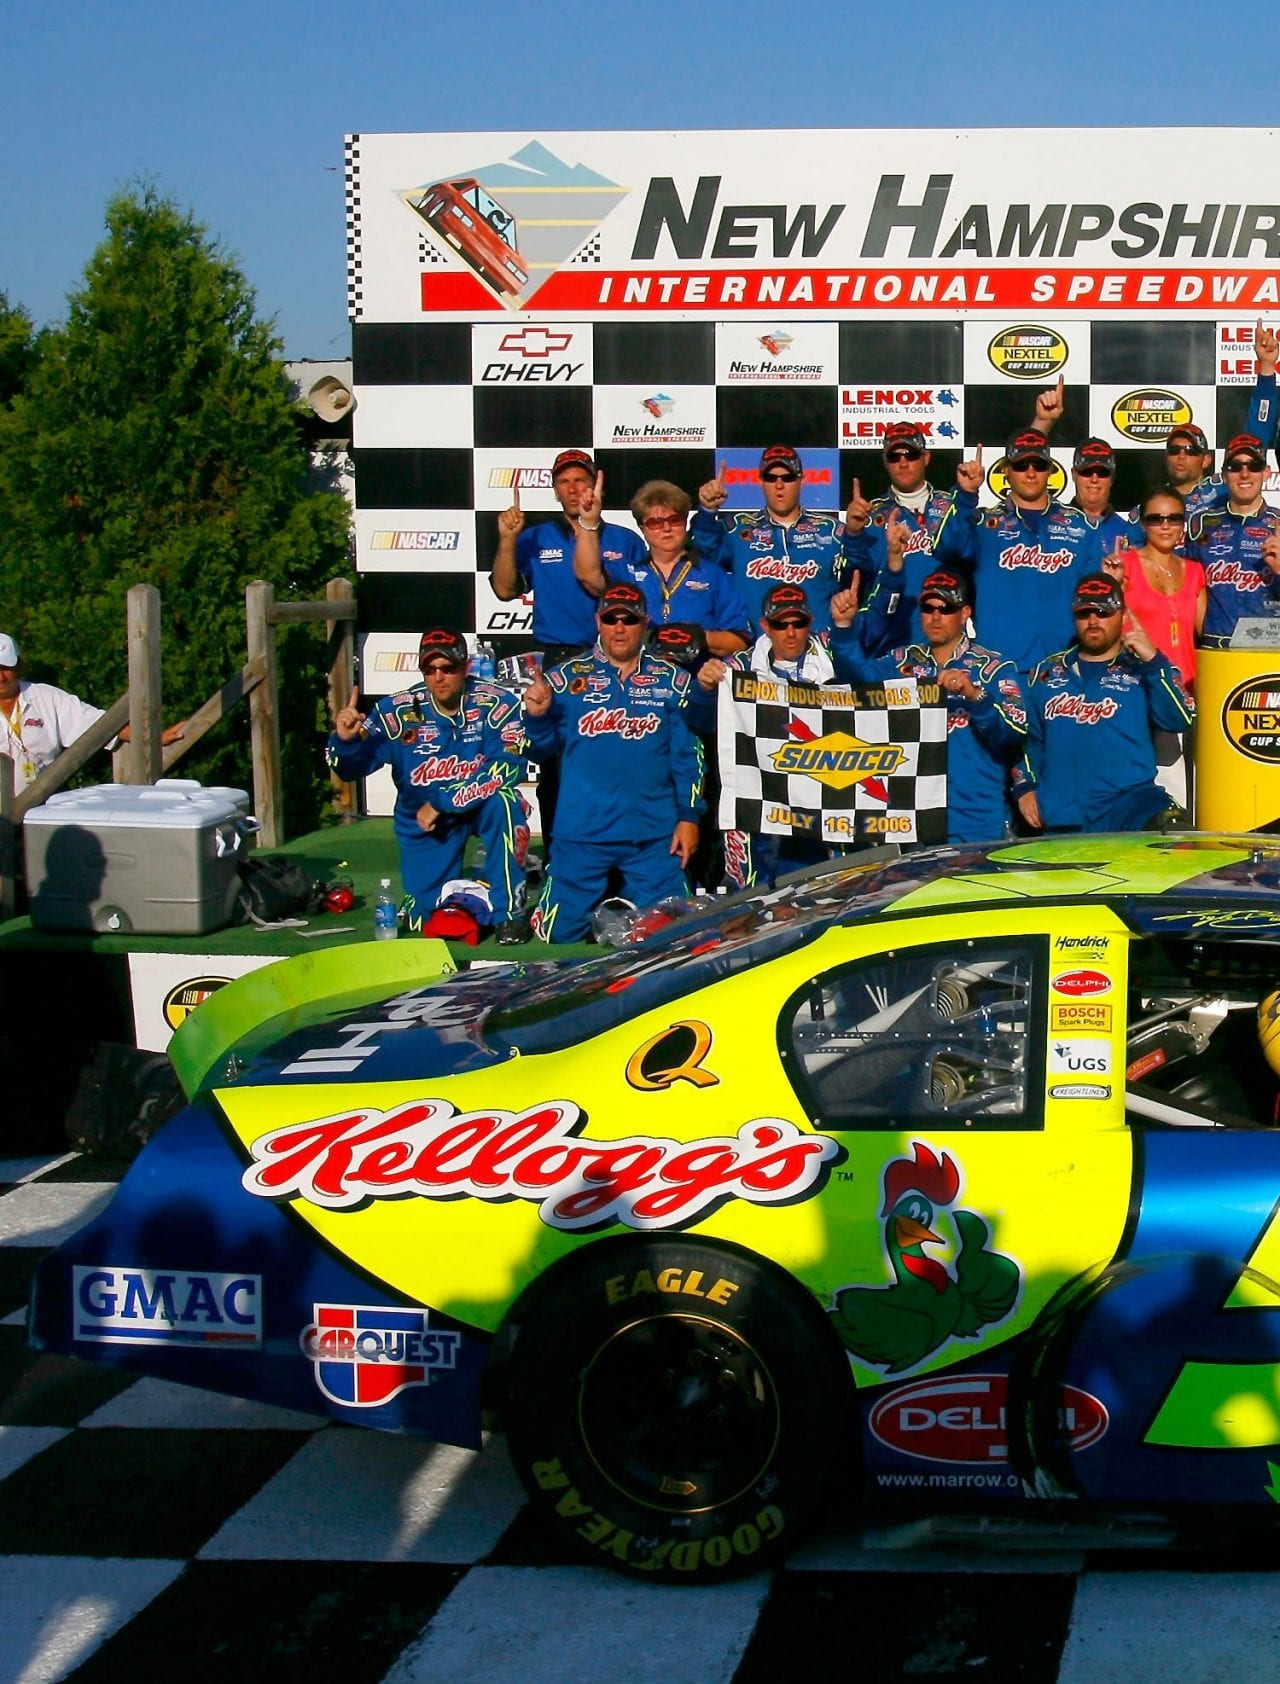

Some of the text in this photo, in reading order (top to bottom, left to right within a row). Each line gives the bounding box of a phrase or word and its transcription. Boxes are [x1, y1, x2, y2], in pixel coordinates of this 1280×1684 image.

[630, 175, 847, 260] NEW
[599, 276, 996, 303] INTERNATIONAL
[1018, 335, 1053, 347] NASCAR
[1004, 349, 1053, 359] NEXTEL
[481, 363, 585, 382] CHEVY
[730, 361, 824, 373] NEW HAMPSHIRE
[1007, 362, 1051, 370] CUP SERIES
[842, 390, 934, 405] LENOX
[1141, 399, 1177, 410] NASCAR
[1128, 413, 1177, 423] NEXTEL
[613, 424, 707, 436] NEW HAMPSHIRE
[842, 422, 934, 437] LENX
[397, 532, 457, 549] NASCAR
[999, 543, 1073, 573] Kellogg's
[747, 556, 819, 584] Kellogg's
[735, 676, 939, 707] LENOX INDUSTRIAL TOOLS 300
[1044, 692, 1118, 724] Kellogg's
[578, 707, 661, 739] Kellogg's
[1250, 736, 1273, 747] CUP
[778, 747, 898, 772] SUNOCO
[767, 807, 814, 829] JULY
[865, 815, 911, 833] 2006
[1055, 936, 1110, 950] Hendrick
[1055, 979, 1109, 988] DELPHI
[1058, 1008, 1106, 1018] BOSCH
[1058, 1019, 1105, 1027] Spark Plugs
[625, 1019, 722, 1091] Q
[1067, 1058, 1107, 1071] UGS
[243, 1098, 838, 1228] Kellogg's
[605, 1267, 740, 1305] EAGLE
[78, 1271, 257, 1325] GMAC
[303, 1326, 457, 1364] CARQUEST
[899, 1407, 1076, 1431] DELI
